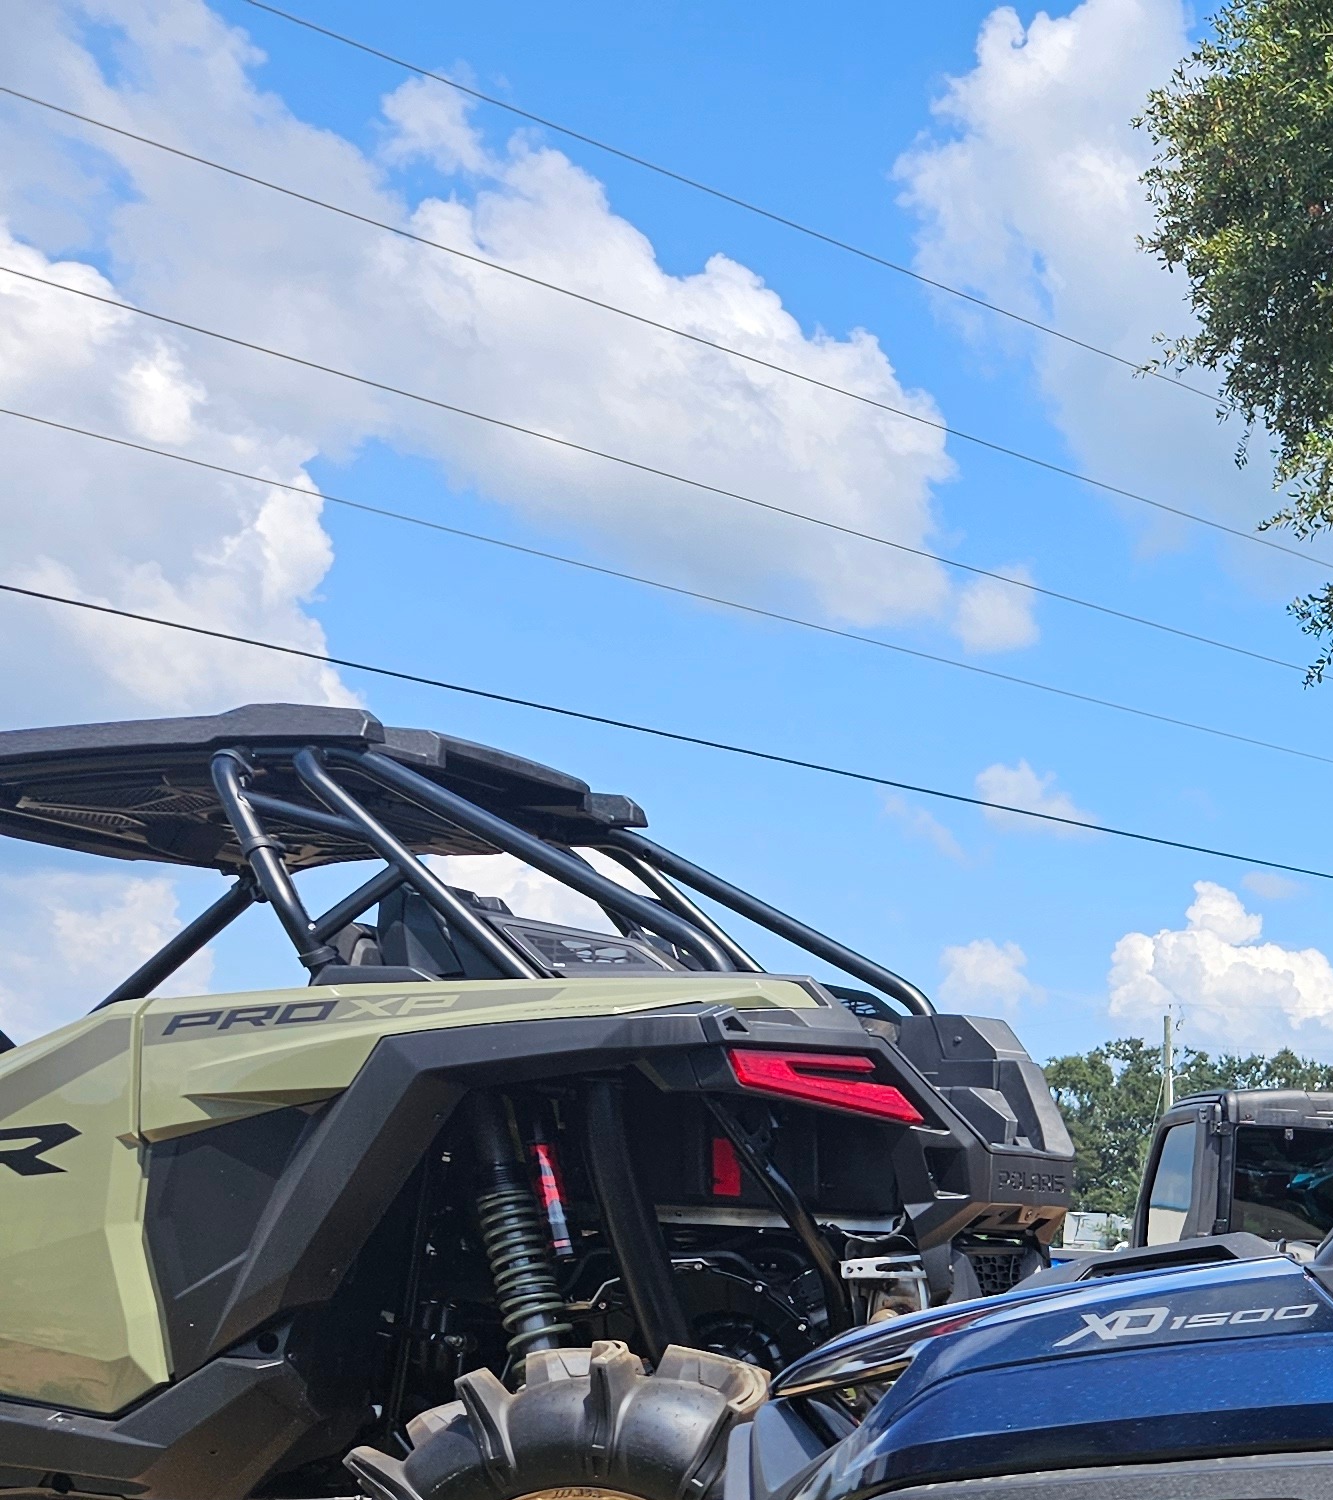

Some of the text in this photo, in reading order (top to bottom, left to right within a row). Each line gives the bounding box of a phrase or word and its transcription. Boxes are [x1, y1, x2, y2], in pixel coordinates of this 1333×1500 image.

[161, 993, 460, 1037] PRO XP
[997, 1169, 1067, 1194] POLARIS
[1052, 1303, 1319, 1348] XD 1500
